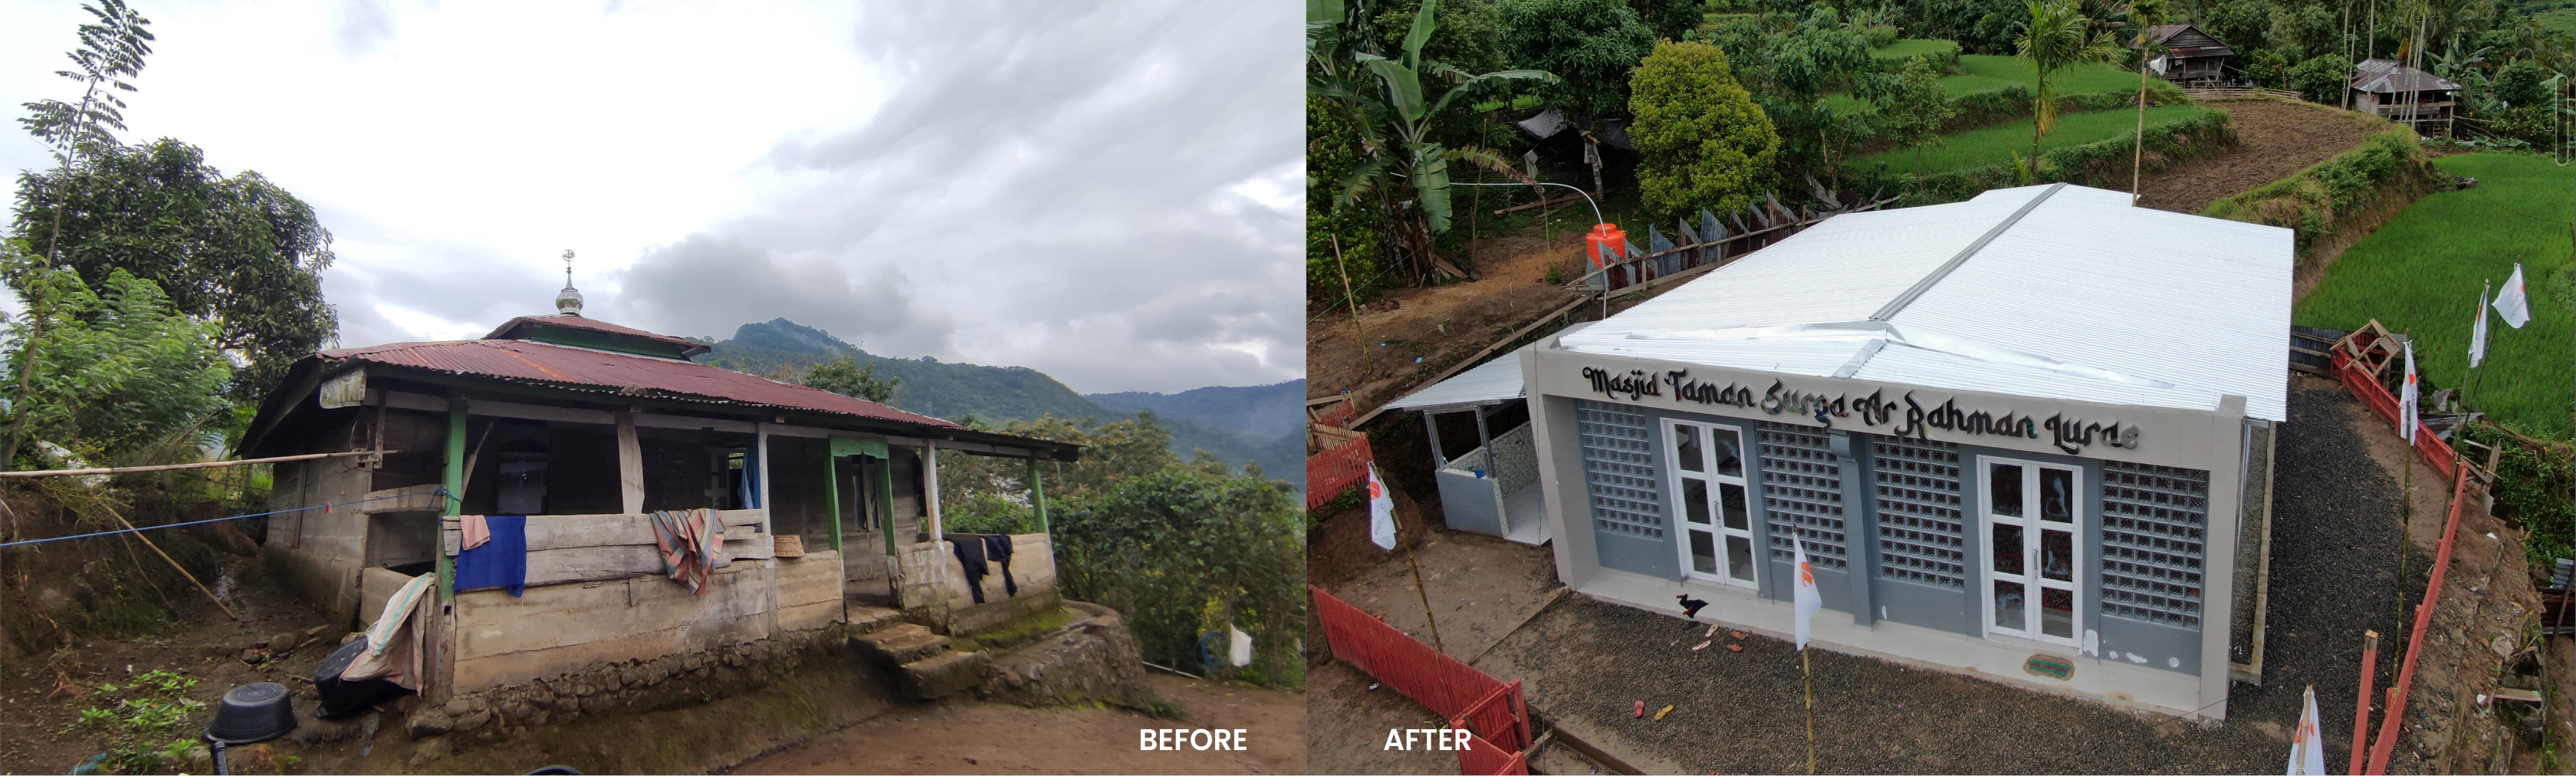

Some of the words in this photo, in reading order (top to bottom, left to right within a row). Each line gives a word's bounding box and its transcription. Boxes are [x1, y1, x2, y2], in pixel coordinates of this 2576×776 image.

[1582, 365, 1663, 402] Masjid
[1664, 367, 1756, 409] Taman
[1760, 377, 1850, 429] Surga
[1852, 387, 1898, 426] Ar
[1894, 390, 2039, 441] Rahman
